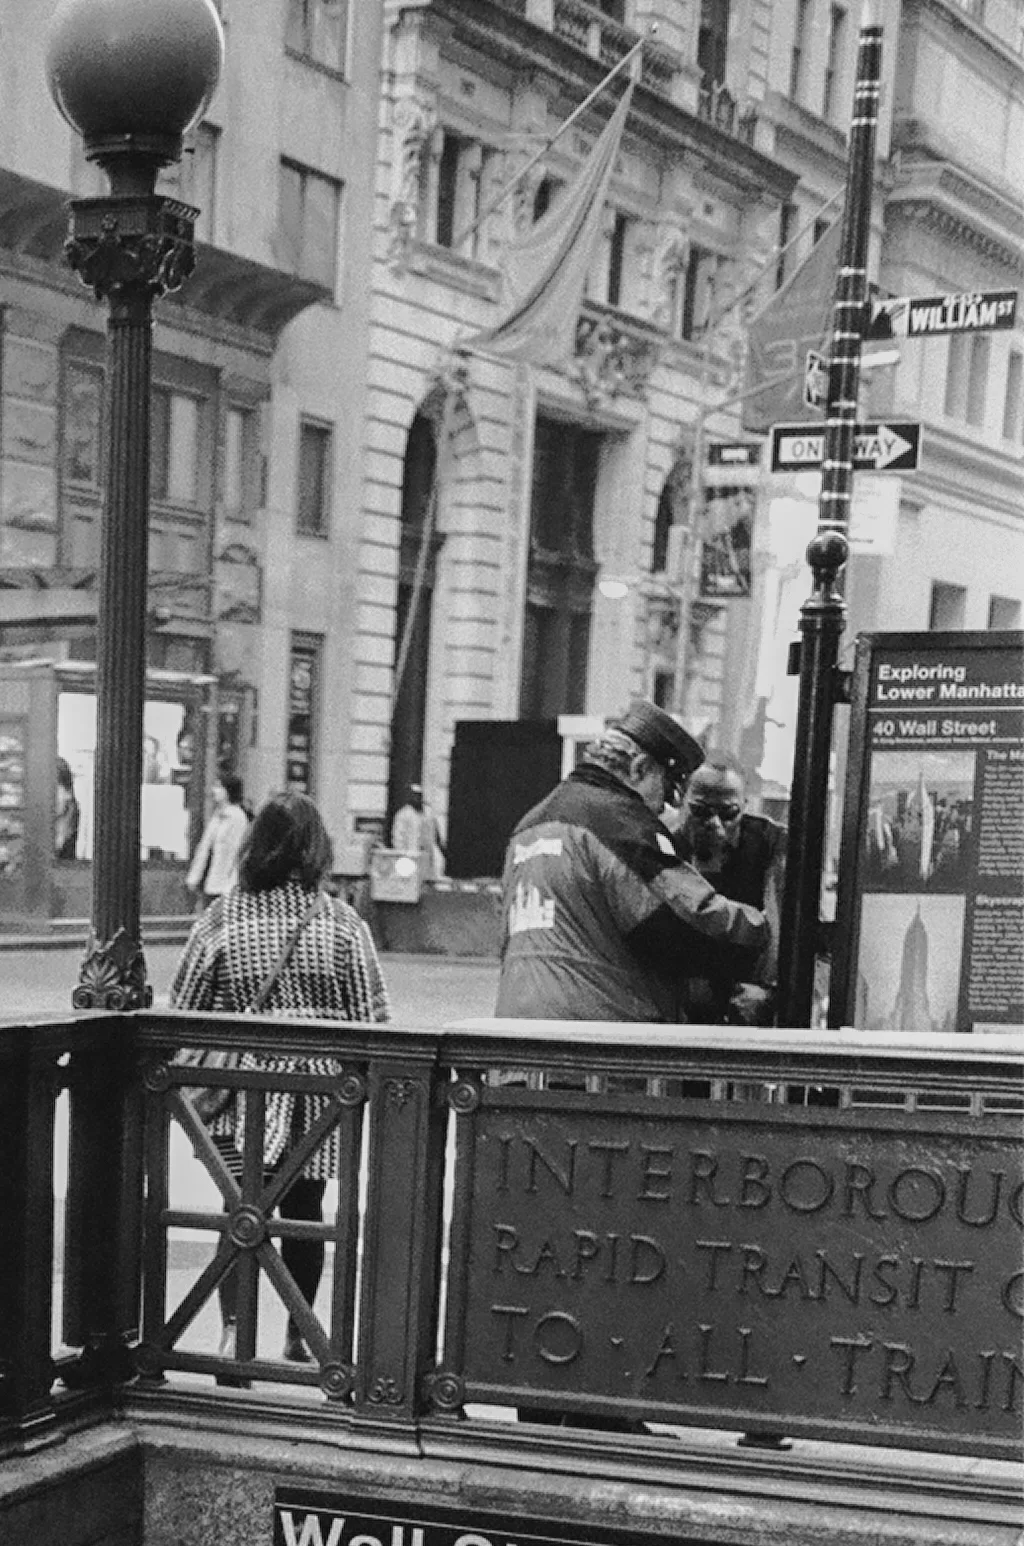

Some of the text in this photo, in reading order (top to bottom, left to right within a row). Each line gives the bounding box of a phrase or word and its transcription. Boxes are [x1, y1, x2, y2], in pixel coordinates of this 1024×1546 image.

[912, 300, 1014, 333] WILLIAM ST
[791, 439, 824, 458] ON
[878, 664, 966, 682] Exploring
[877, 684, 935, 700] Lower
[873, 720, 996, 736] 40 Wall Street
[492, 1223, 669, 1285] RAPID
[695, 1239, 975, 1315] TRANSIT
[490, 1305, 583, 1363] TO
[645, 1322, 769, 1388] ALL
